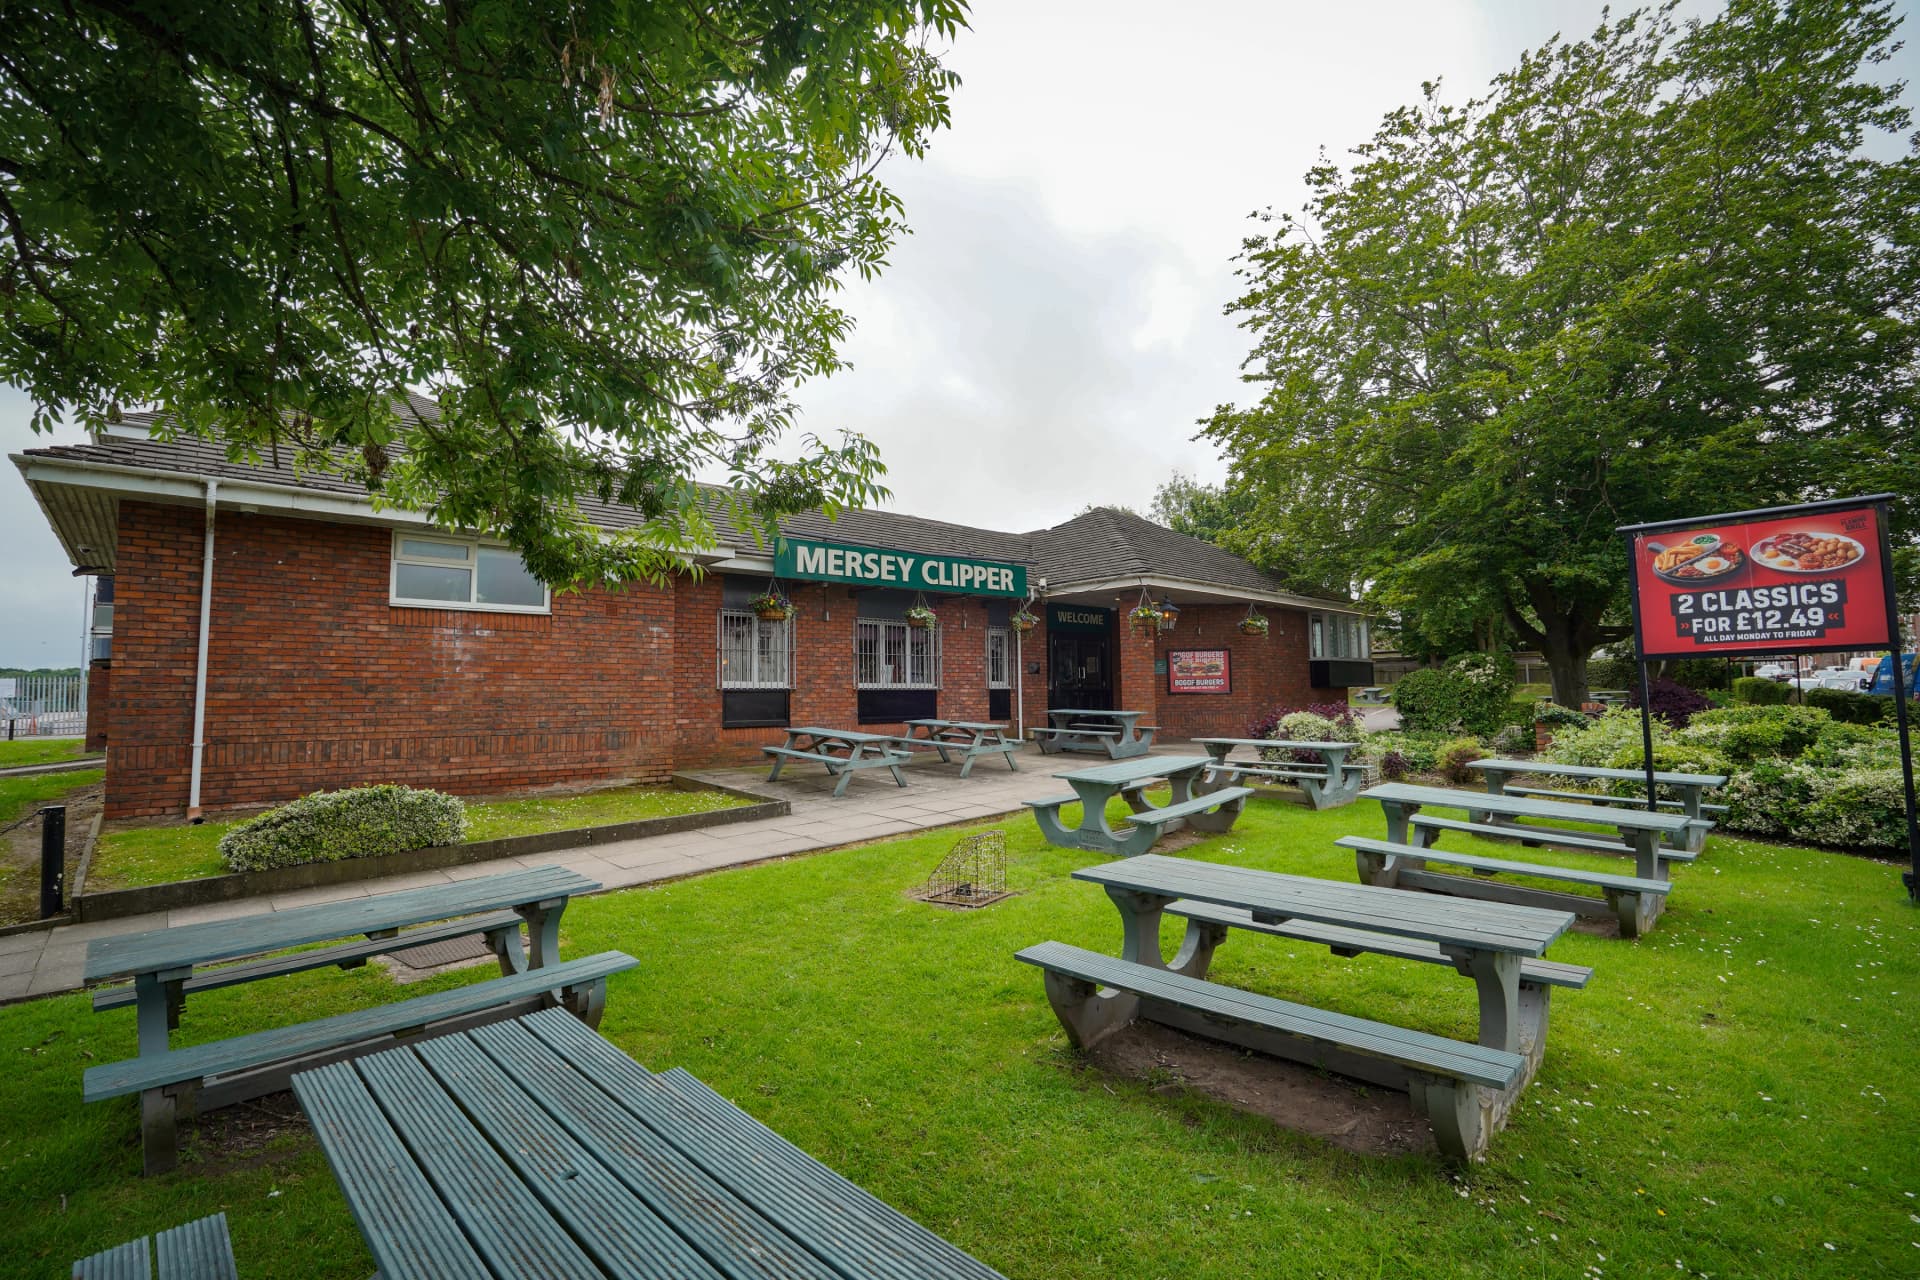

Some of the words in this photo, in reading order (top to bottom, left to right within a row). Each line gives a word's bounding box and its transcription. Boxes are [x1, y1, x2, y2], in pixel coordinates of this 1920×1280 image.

[796, 545, 914, 582] MERSEY
[921, 560, 1015, 592] CLIPPER
[1678, 594, 1694, 614] 2
[1701, 583, 1838, 613] CLASSICS
[1057, 610, 1104, 625] WELCOME
[1692, 617, 1731, 634] FOR
[1737, 607, 1824, 631] £12.49
[1703, 635, 1718, 643] ALL
[1720, 634, 1735, 642] DAY
[1737, 631, 1771, 641] MONDAY
[1773, 631, 1784, 640] TO
[1785, 629, 1817, 639] FRIDAY
[1196, 678, 1224, 686] BURGERS
